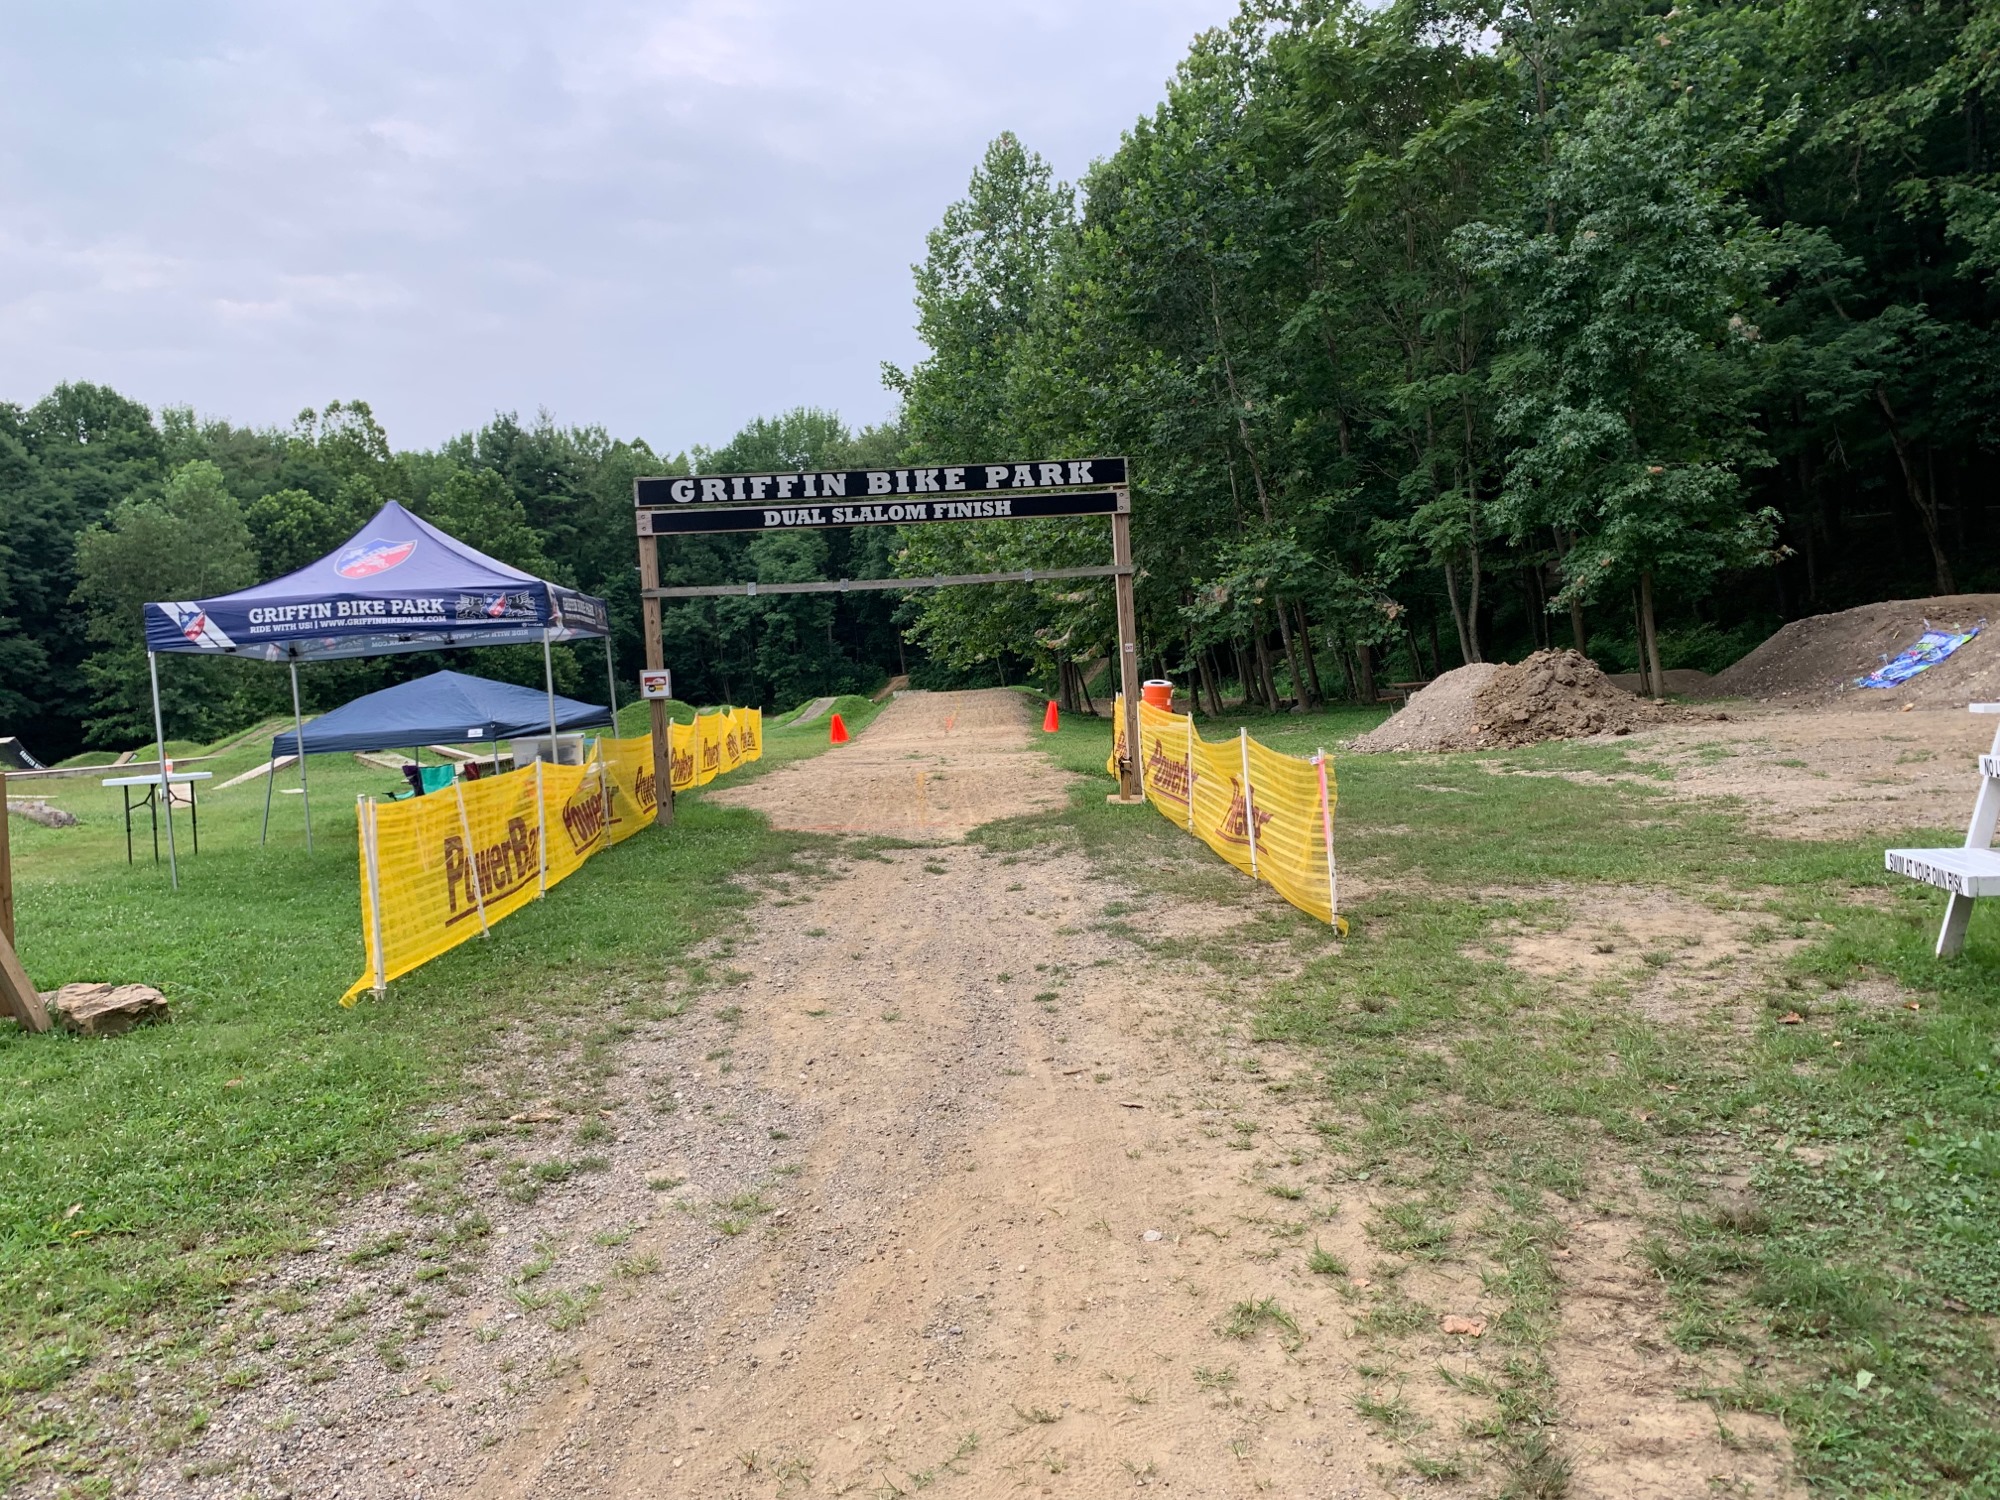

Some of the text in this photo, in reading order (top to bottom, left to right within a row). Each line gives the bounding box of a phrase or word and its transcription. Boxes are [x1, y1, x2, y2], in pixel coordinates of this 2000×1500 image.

[671, 461, 1094, 503] GRIFFIN BIKE PARK
[764, 500, 1012, 527] DUAL SLALOM FINISH
[249, 598, 446, 624] GRIFFIN BIKE PARK
[249, 625, 272, 634] RIDE
[273, 622, 297, 632] WITH
[298, 621, 313, 630] US!
[320, 615, 447, 628] WWW.GRIFFINBIKEPARK.COM
[1984, 757, 1994, 776] NO
[1889, 853, 1963, 895] SWIM AT YOUR OWN RISK
